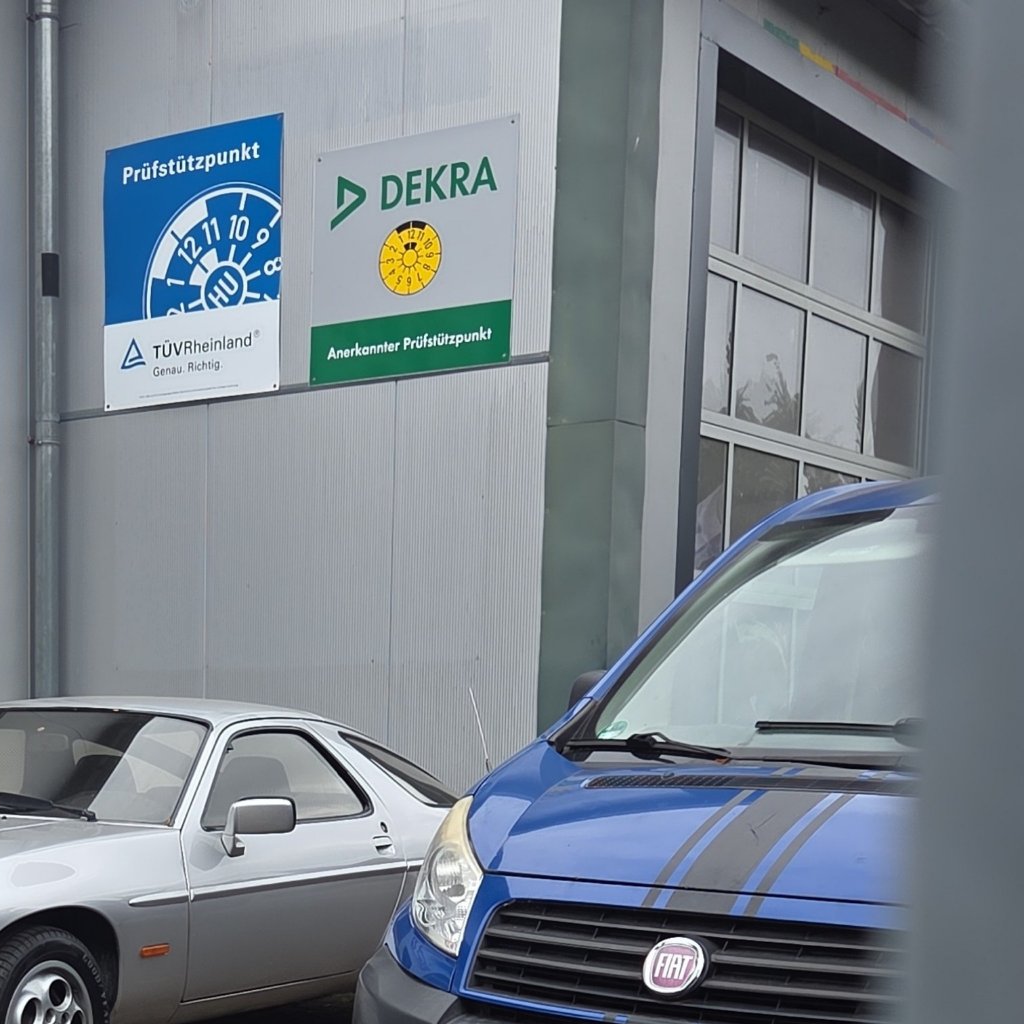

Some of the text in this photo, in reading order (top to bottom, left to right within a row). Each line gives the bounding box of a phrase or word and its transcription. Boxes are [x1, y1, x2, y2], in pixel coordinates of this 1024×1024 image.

[122, 141, 261, 185] Prüfstützpunkt
[381, 156, 497, 210] DEKRA
[202, 217, 220, 245] 11
[229, 214, 249, 241] 10
[250, 228, 270, 249] 9
[408, 229, 415, 239] 12
[178, 236, 202, 265] 12
[207, 271, 239, 308] HU
[327, 326, 492, 360] Anerkannter Prüfstützpunkt
[153, 360, 224, 377] Genau. Richtig.
[654, 952, 694, 980] FIAT
